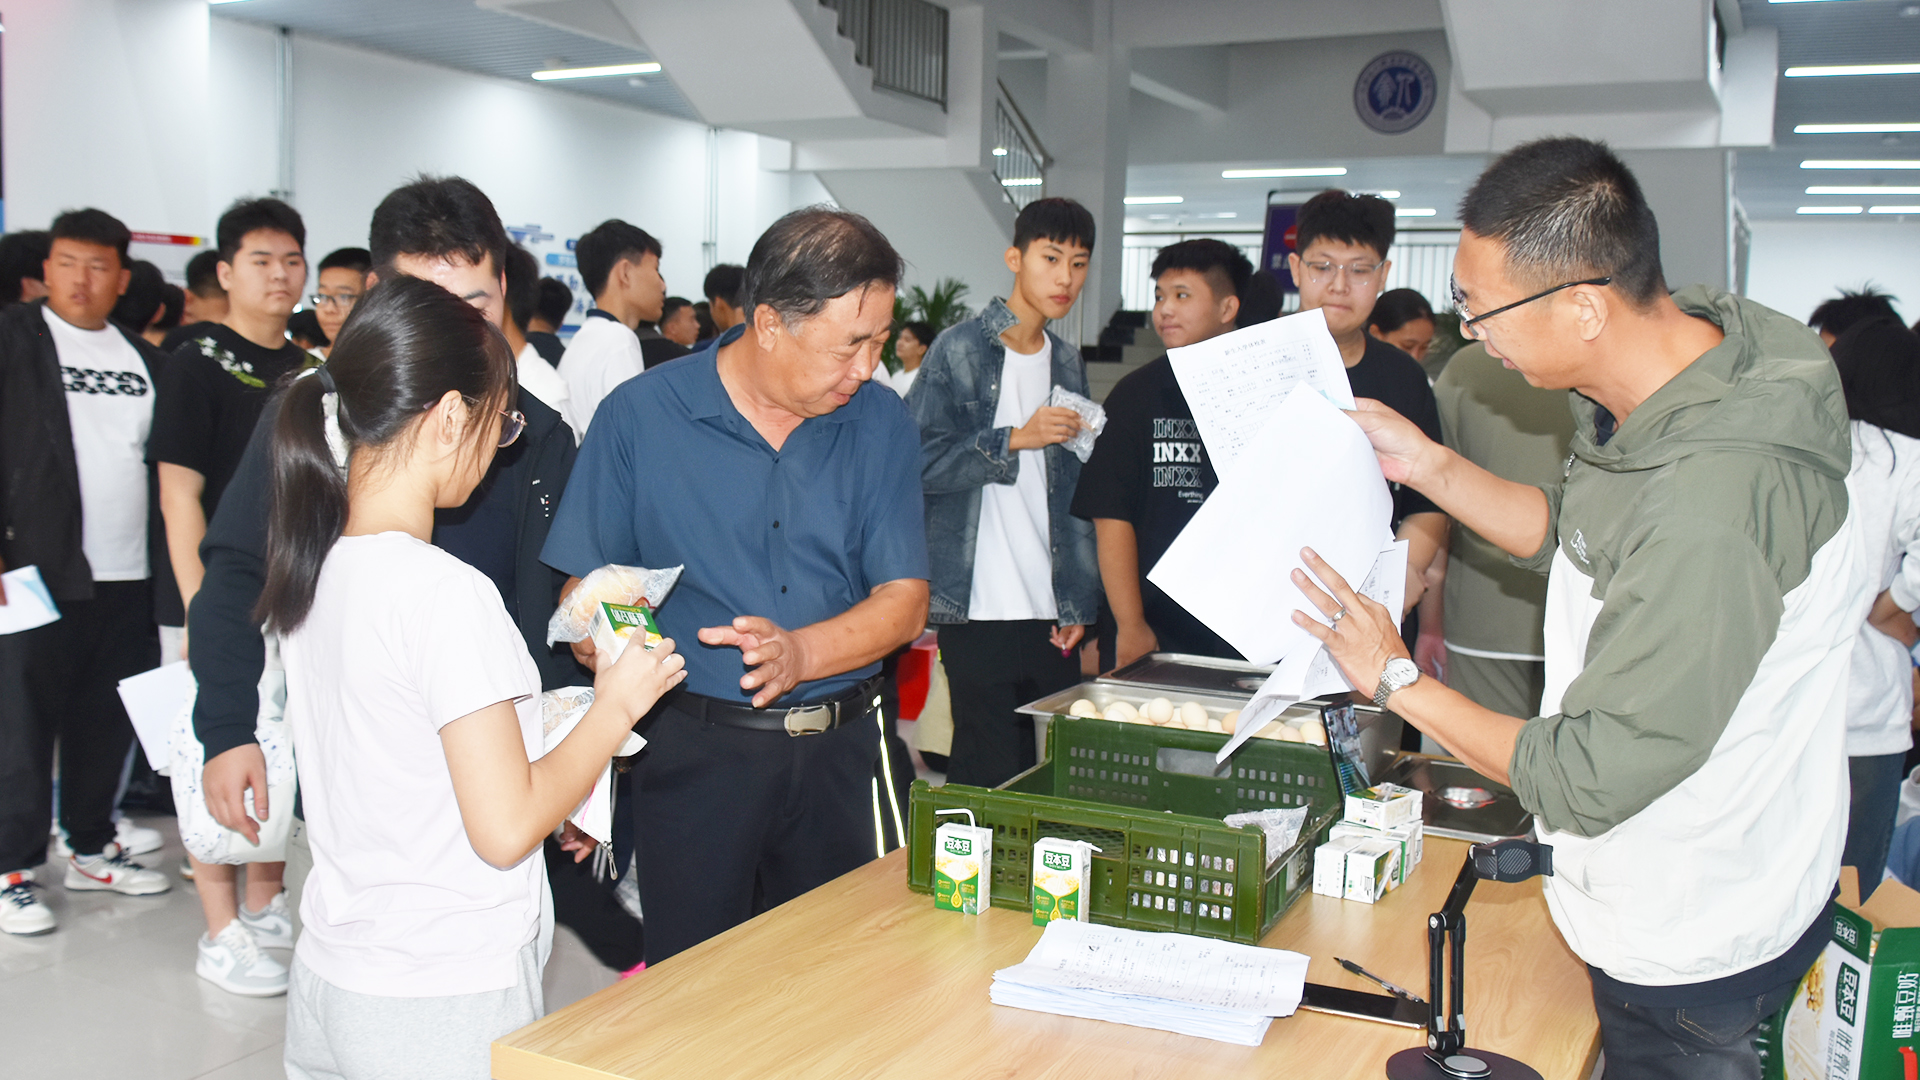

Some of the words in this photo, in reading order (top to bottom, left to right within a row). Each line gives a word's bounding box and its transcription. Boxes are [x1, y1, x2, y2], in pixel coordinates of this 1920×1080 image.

[1153, 418, 1200, 439] INXX
[1153, 442, 1201, 463] INXX
[1153, 466, 1202, 487] INXX
[946, 838, 970, 852] 豆本豆
[1045, 852, 1070, 867] 豆本豆
[1836, 921, 1857, 945] 豆本豆
[1841, 968, 1858, 1021] 豆本豆
[1892, 972, 1919, 1038] 唯甄豆奶
